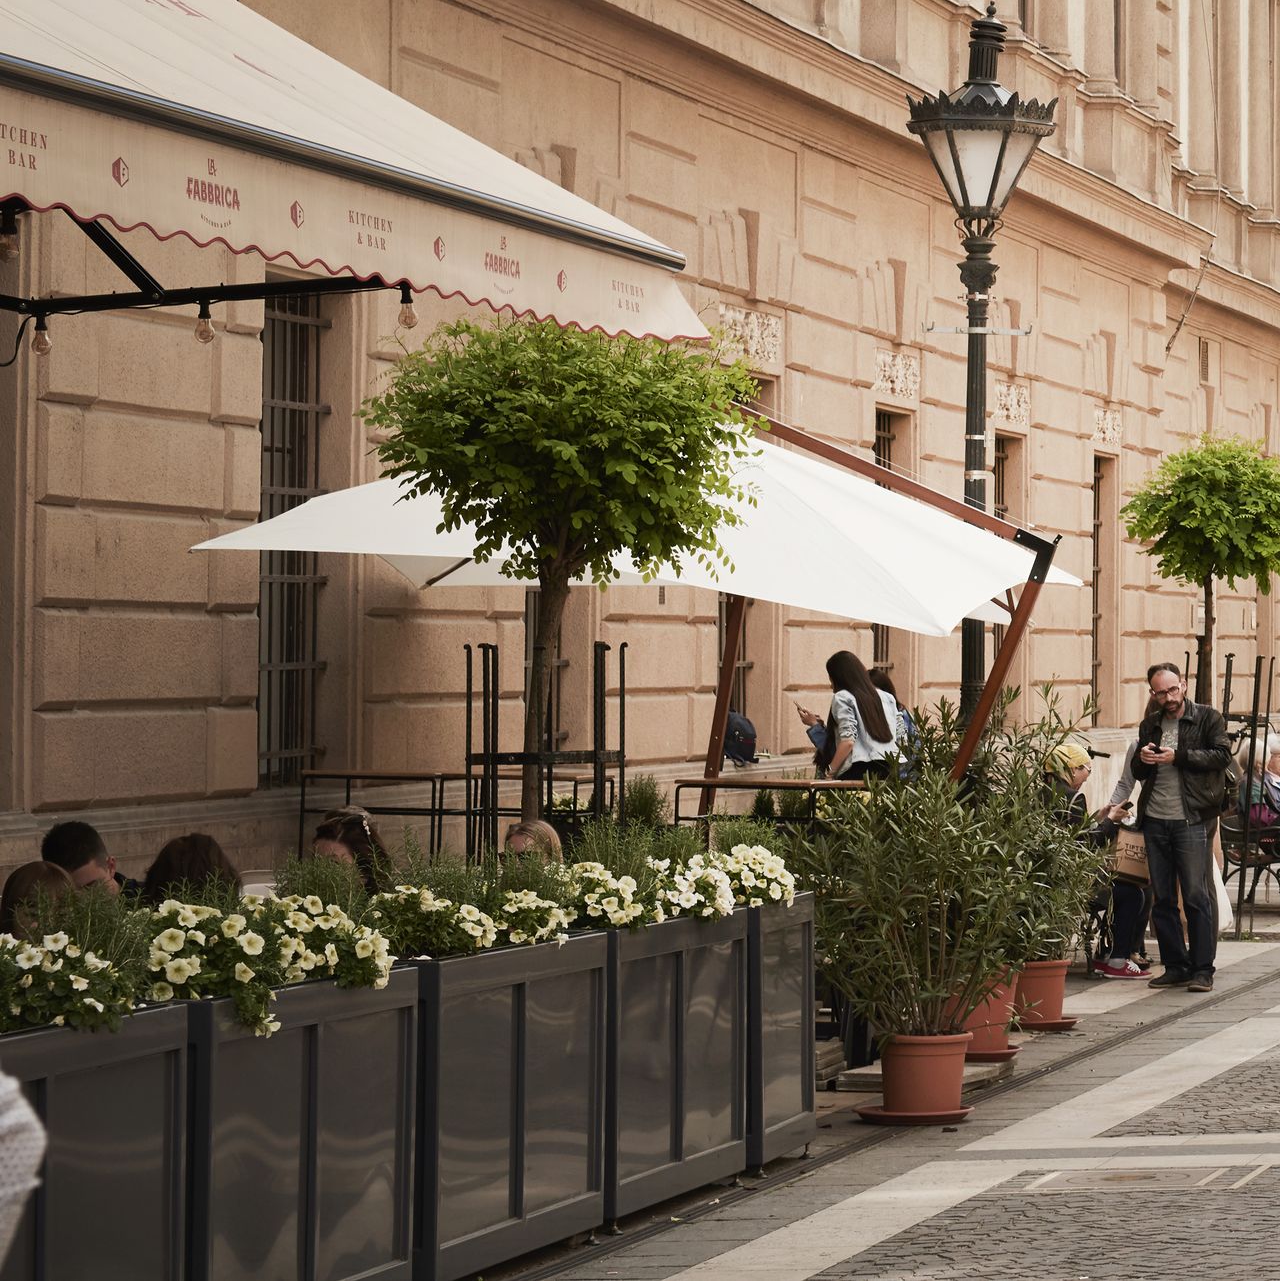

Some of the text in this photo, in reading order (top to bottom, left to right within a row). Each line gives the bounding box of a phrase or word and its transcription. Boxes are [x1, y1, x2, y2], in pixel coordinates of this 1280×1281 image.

[8, 149, 37, 170] BAR
[186, 176, 241, 211] FABBRICA
[349, 210, 393, 233] KITCHEN
[357, 232, 386, 251] & BAR
[484, 251, 521, 280] FABBRICA
[612, 279, 645, 299] KITCHEN
[625, 301, 640, 313] BAR
